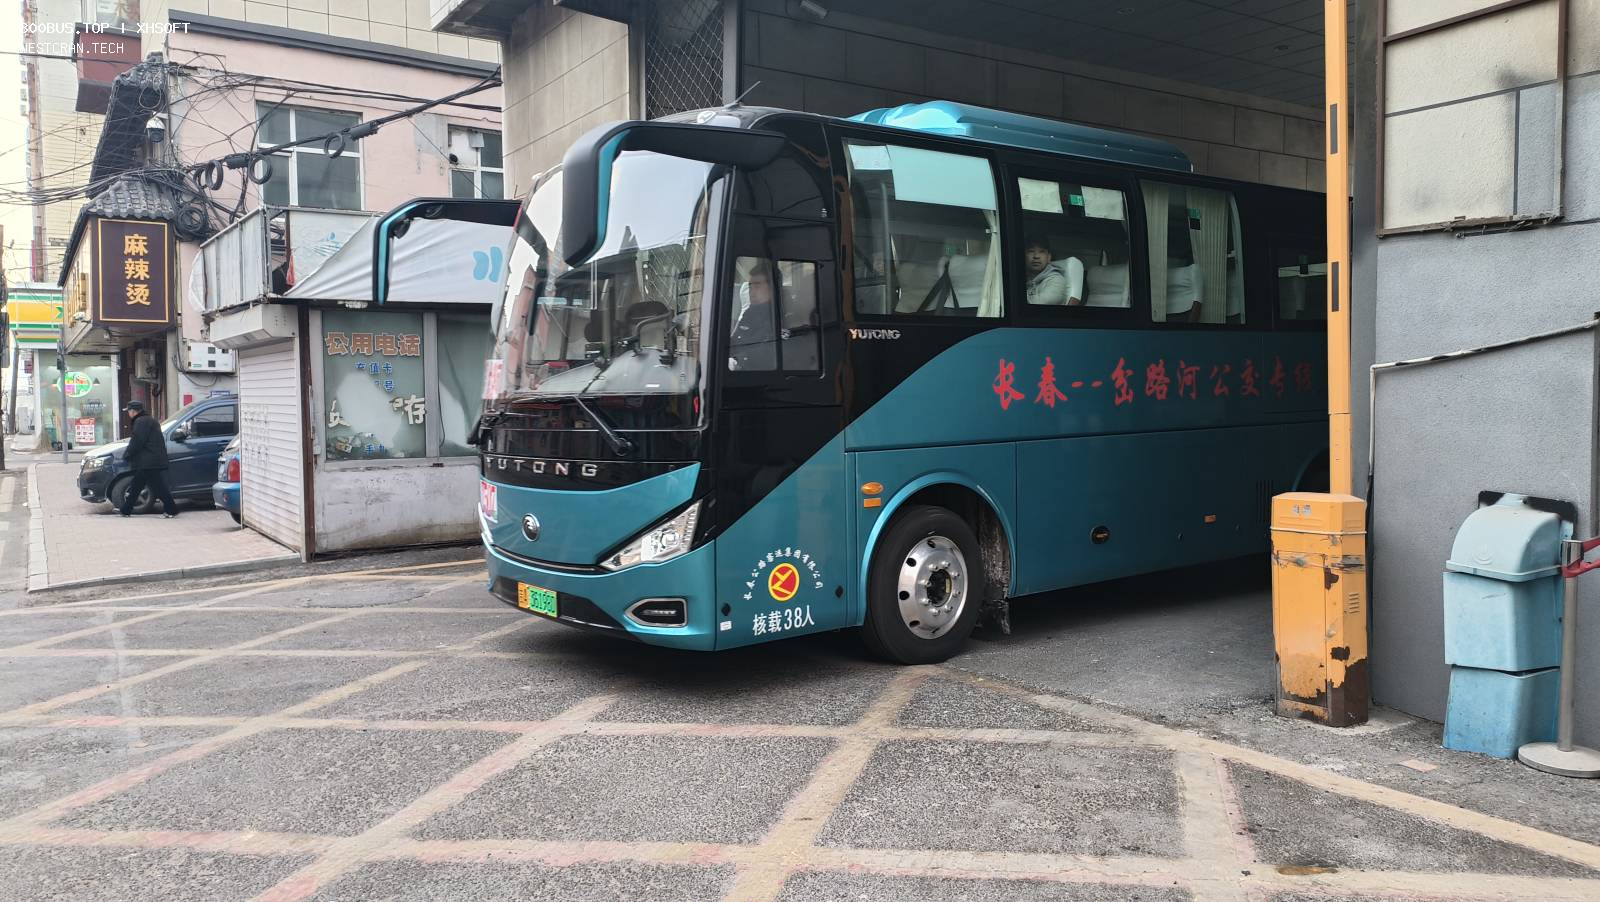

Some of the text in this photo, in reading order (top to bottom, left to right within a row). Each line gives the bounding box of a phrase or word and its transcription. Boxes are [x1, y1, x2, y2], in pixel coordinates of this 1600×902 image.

[124, 233, 151, 306] 麻辣烫
[325, 332, 421, 356] 公用电话
[848, 328, 901, 340] YUTONG
[752, 604, 815, 636] 核载38人
